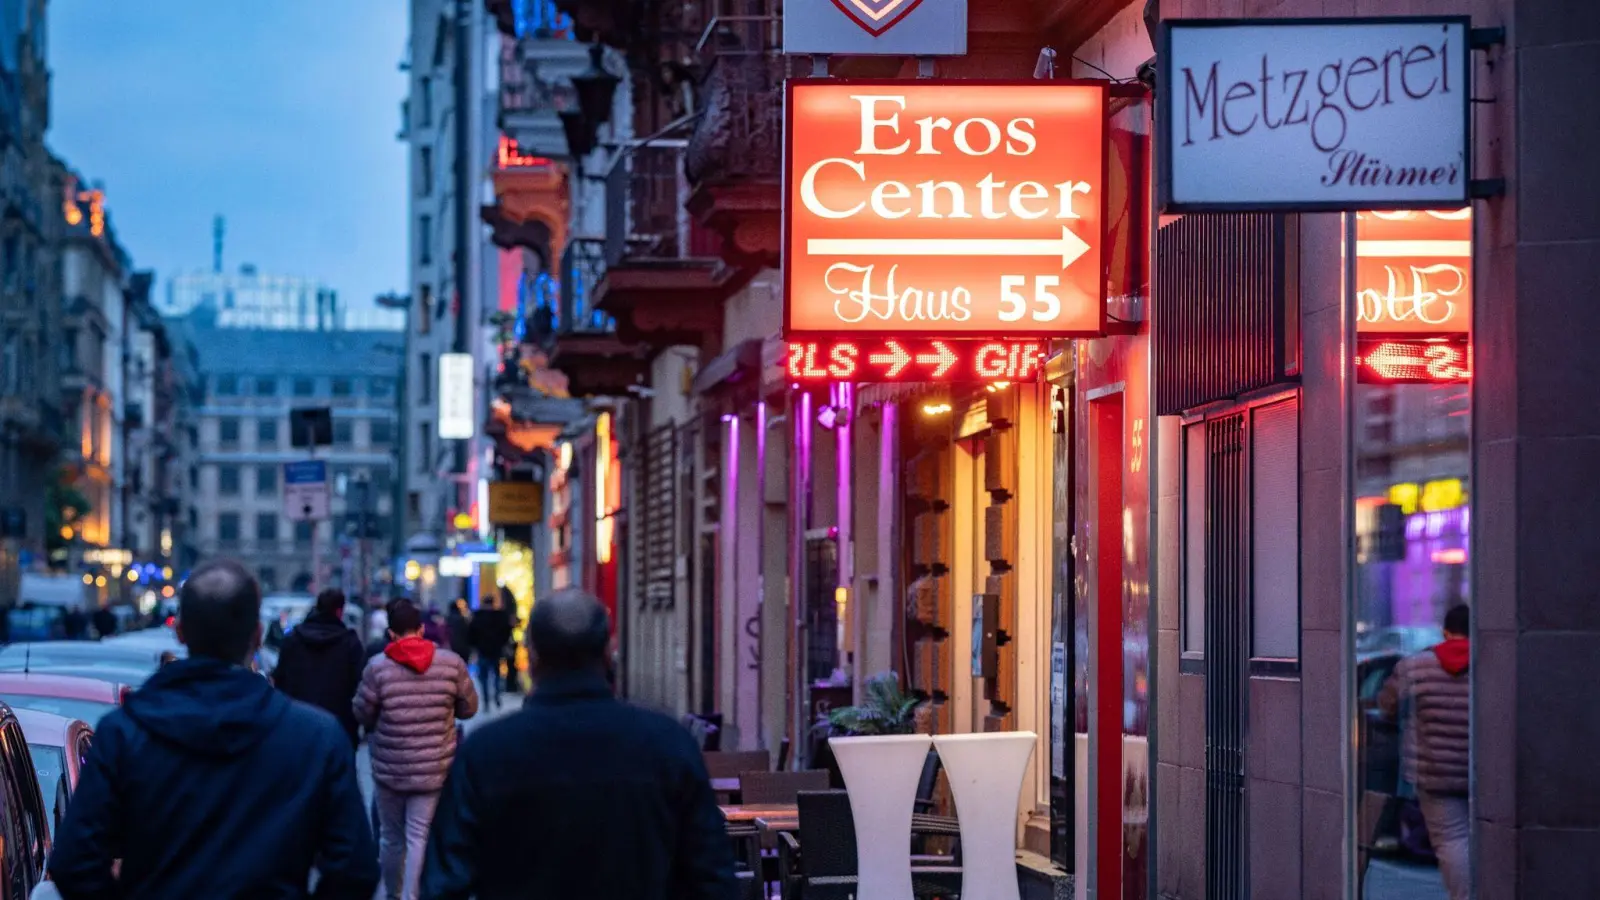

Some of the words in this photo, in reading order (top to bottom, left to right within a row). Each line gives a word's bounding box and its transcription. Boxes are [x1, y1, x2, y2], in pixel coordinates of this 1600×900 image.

[1180, 24, 1451, 151] Metzgerei
[850, 95, 1036, 156] Eros
[800, 158, 1091, 219] Center
[1320, 149, 1463, 188] Stürmer
[824, 262, 971, 323] Haus
[997, 275, 1061, 322] 55
